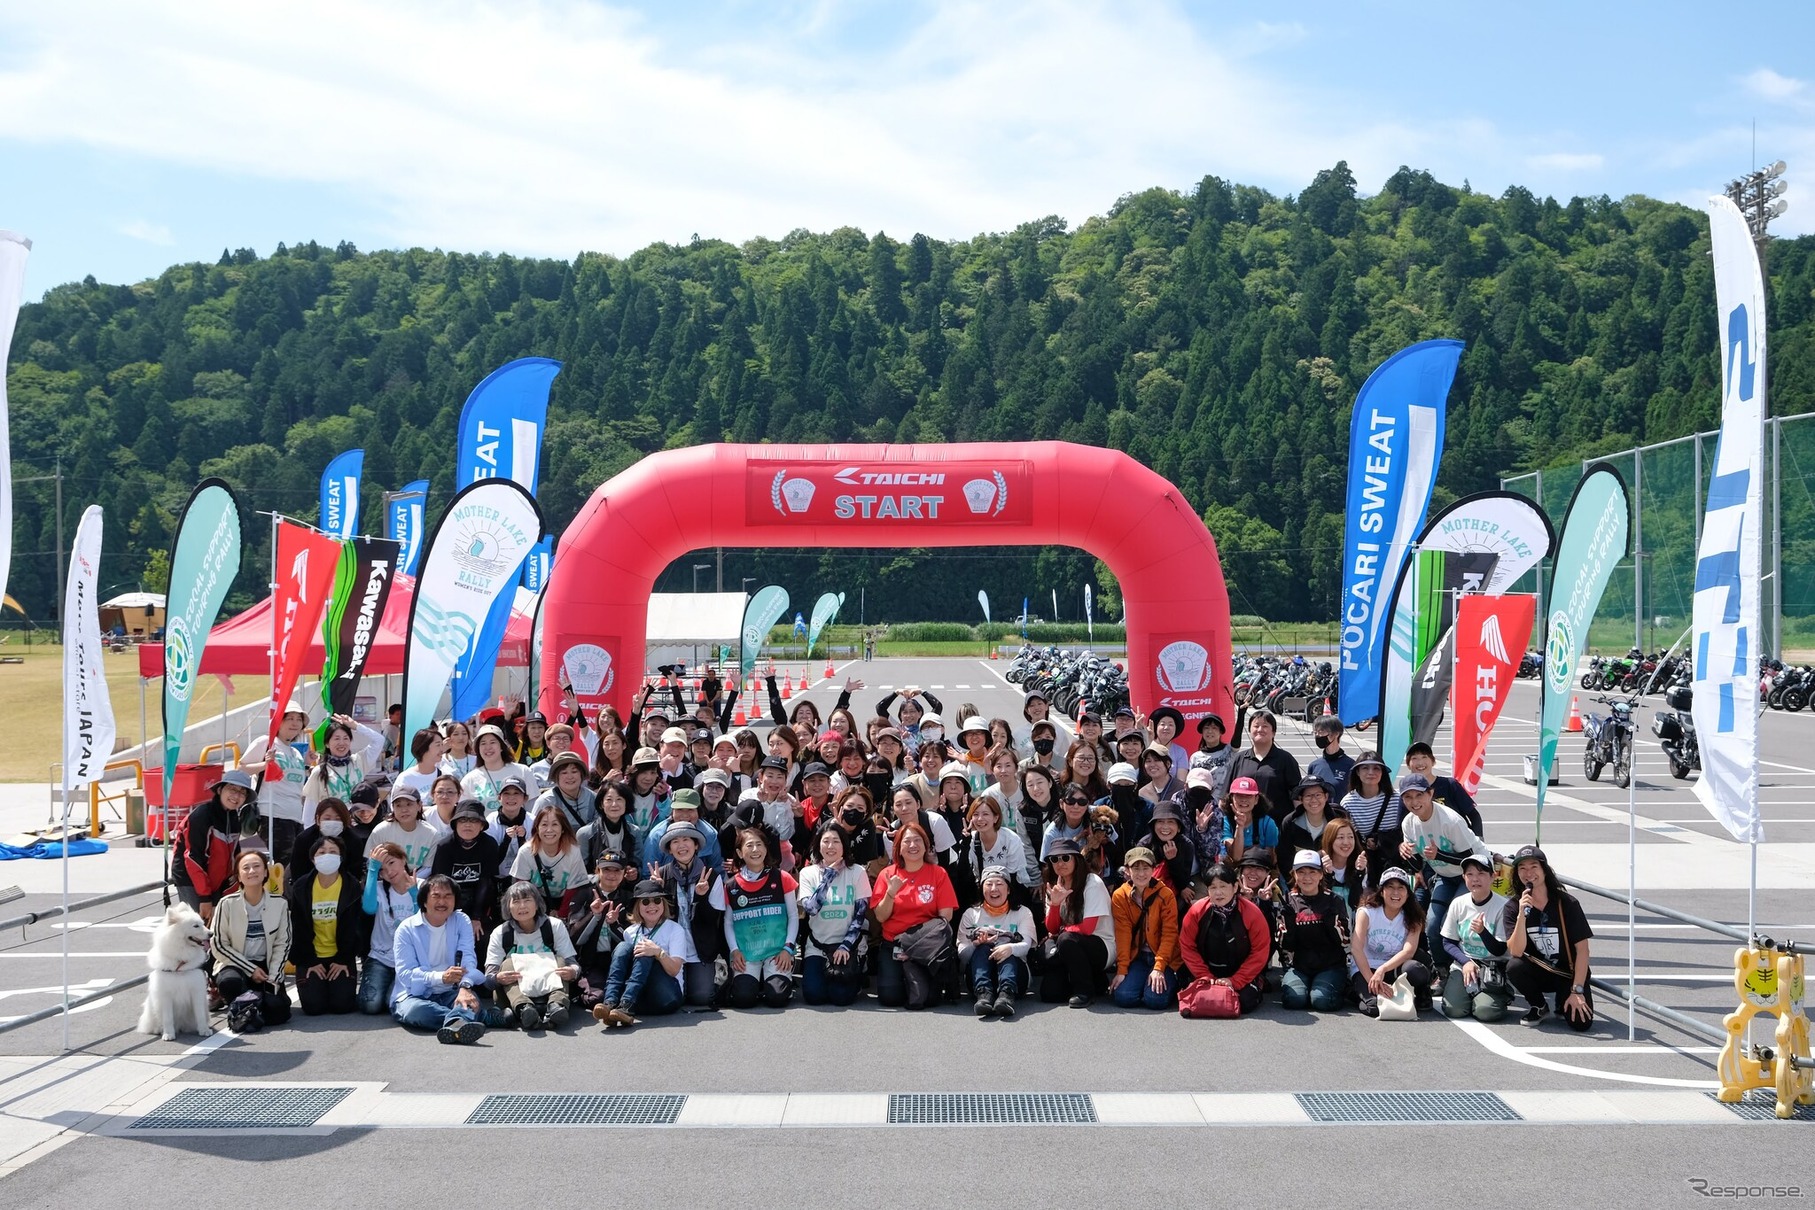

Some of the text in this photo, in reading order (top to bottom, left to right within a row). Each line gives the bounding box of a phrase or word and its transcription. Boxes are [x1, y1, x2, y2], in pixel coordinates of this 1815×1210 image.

[473, 420, 500, 482] EAT
[859, 473, 945, 485] TAICHI
[328, 479, 340, 528] SWEAT
[835, 495, 944, 519] START
[397, 506, 407, 550] SWEAT
[453, 505, 527, 546] MOTHER LAKE
[1343, 408, 1396, 671] POCARI SWEAT
[1440, 518, 1532, 558] MOTHER LAKE
[186, 502, 232, 624] SOCIAL SUPPORT
[529, 554, 538, 588] SWEAT
[1568, 487, 1618, 616] SOCIAL SUPPORT
[1573, 513, 1621, 627] TOURING RALLY
[191, 527, 234, 635] TOURING RALLY
[458, 570, 492, 589] RALLY
[1172, 698, 1212, 706] TAICHI
[732, 906, 782, 921] SUPPORT RIDER
[813, 884, 855, 906] LR
[824, 911, 845, 919] 2024
